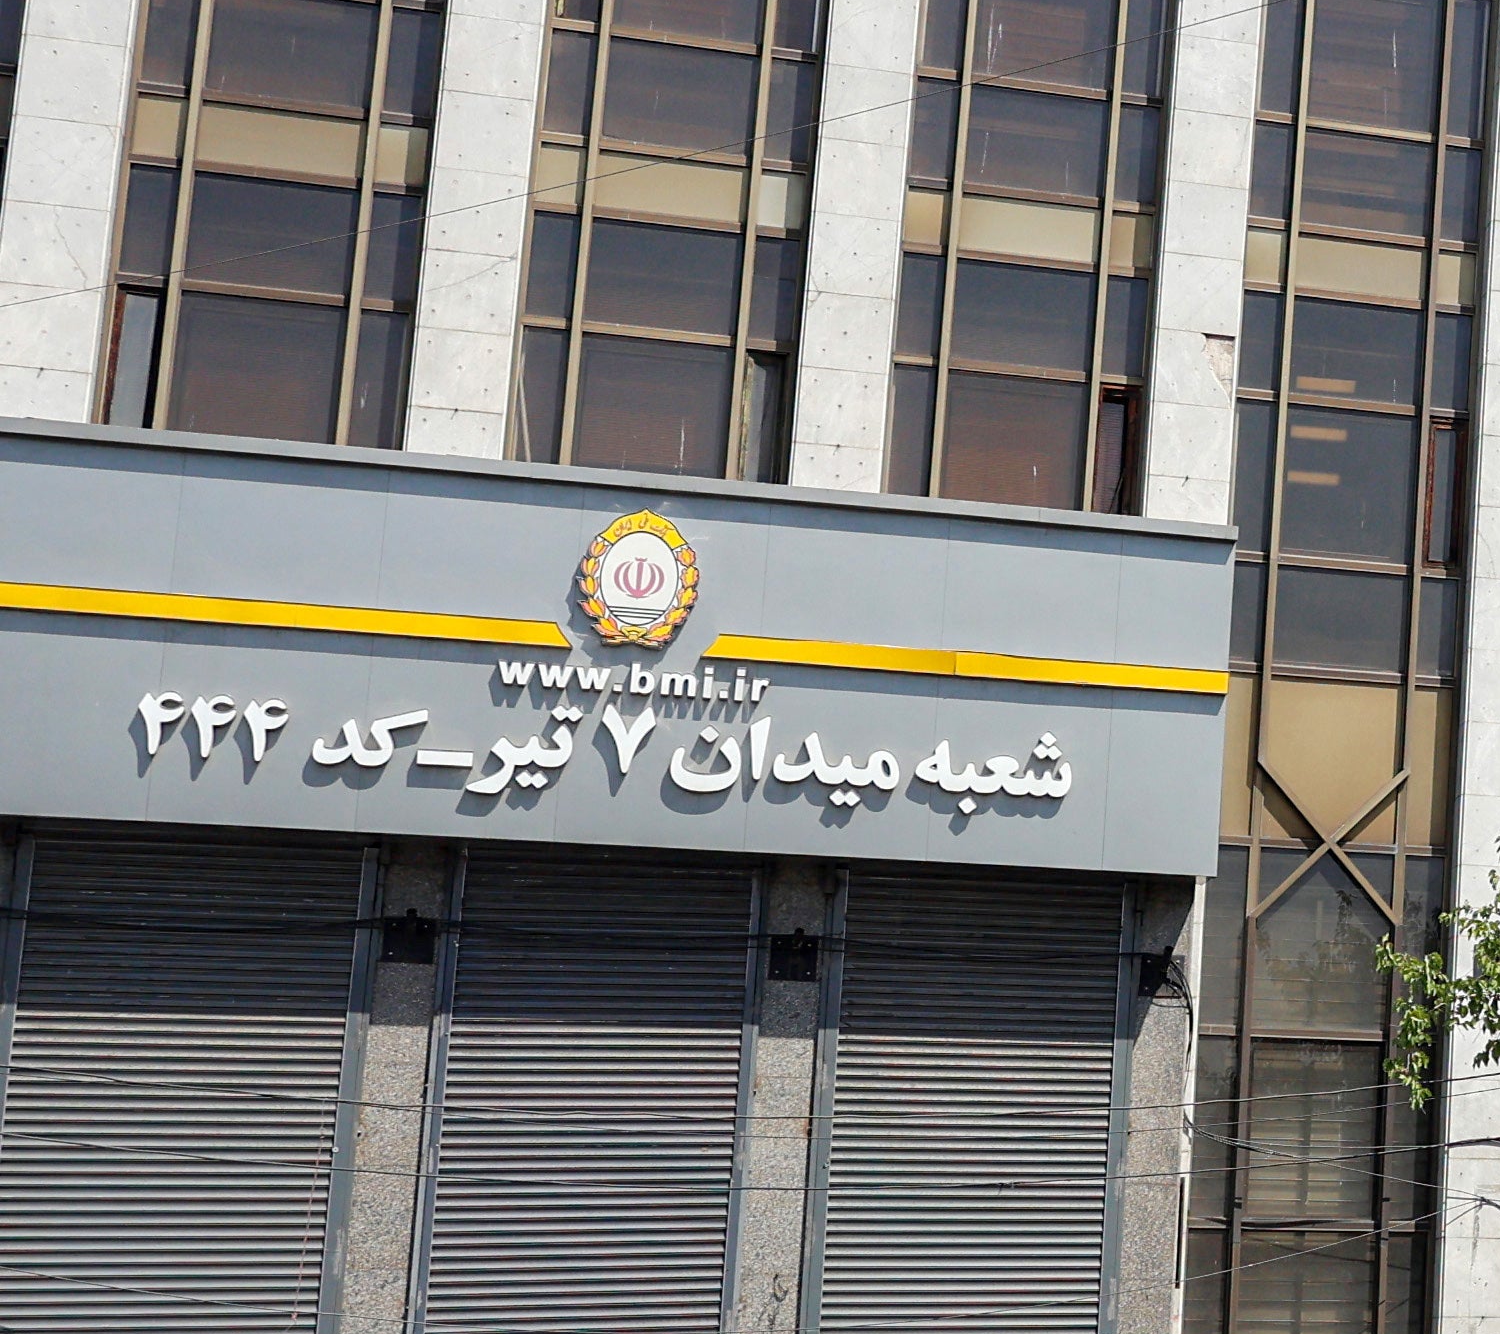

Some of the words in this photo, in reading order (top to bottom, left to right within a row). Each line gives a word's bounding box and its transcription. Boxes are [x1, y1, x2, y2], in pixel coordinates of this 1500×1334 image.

[498, 660, 770, 703] www.bmi.ir
[137, 690, 290, 762] ۴۴۴
[311, 708, 430, 767] کد
[465, 704, 584, 794] تیر
[601, 703, 657, 774] ۷
[669, 716, 901, 807] میدان
[915, 730, 1073, 815] شعبه
